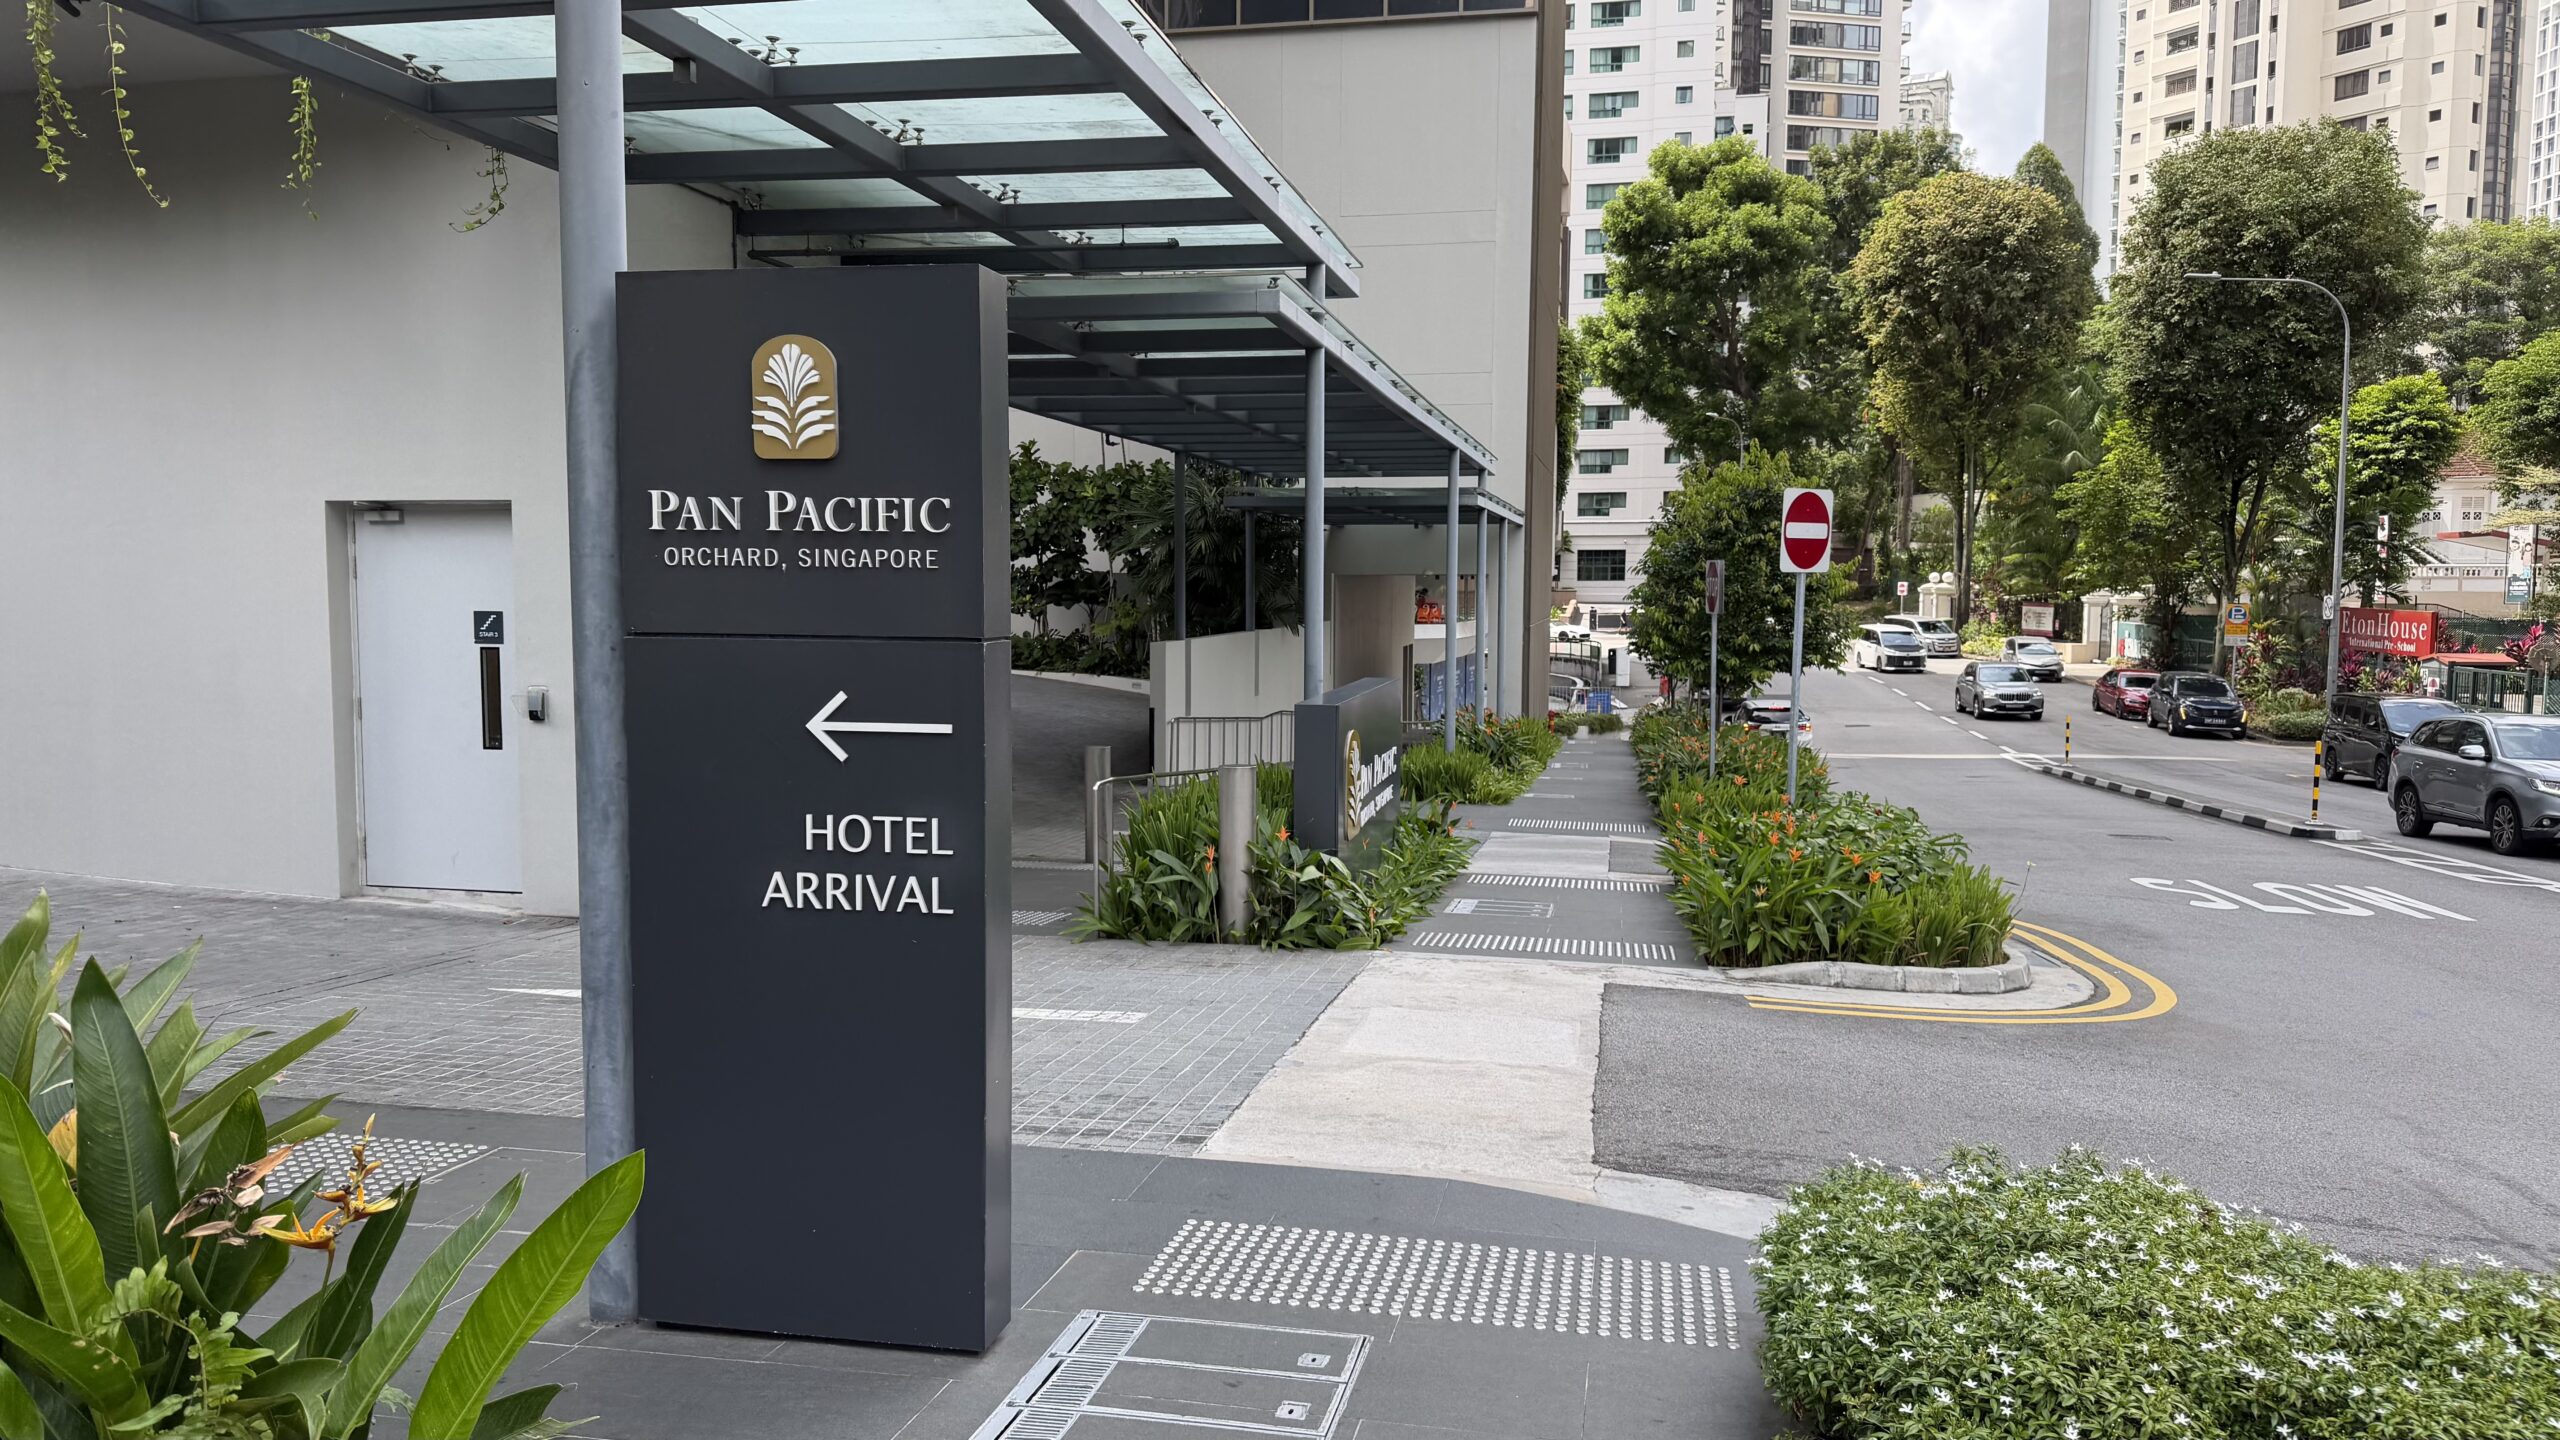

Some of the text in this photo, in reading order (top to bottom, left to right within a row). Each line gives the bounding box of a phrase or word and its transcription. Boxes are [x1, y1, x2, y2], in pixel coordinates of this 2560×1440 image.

[647, 489, 952, 533] PAN PACIFIC
[664, 547, 939, 570] ORCHARD, SINGAPORE
[2341, 610, 2428, 641] EtonHouse
[2349, 637, 2384, 649] International
[805, 813, 954, 855] HOTEL
[761, 870, 954, 915] ARRIVAL
[2128, 876, 2478, 922] SLOW
